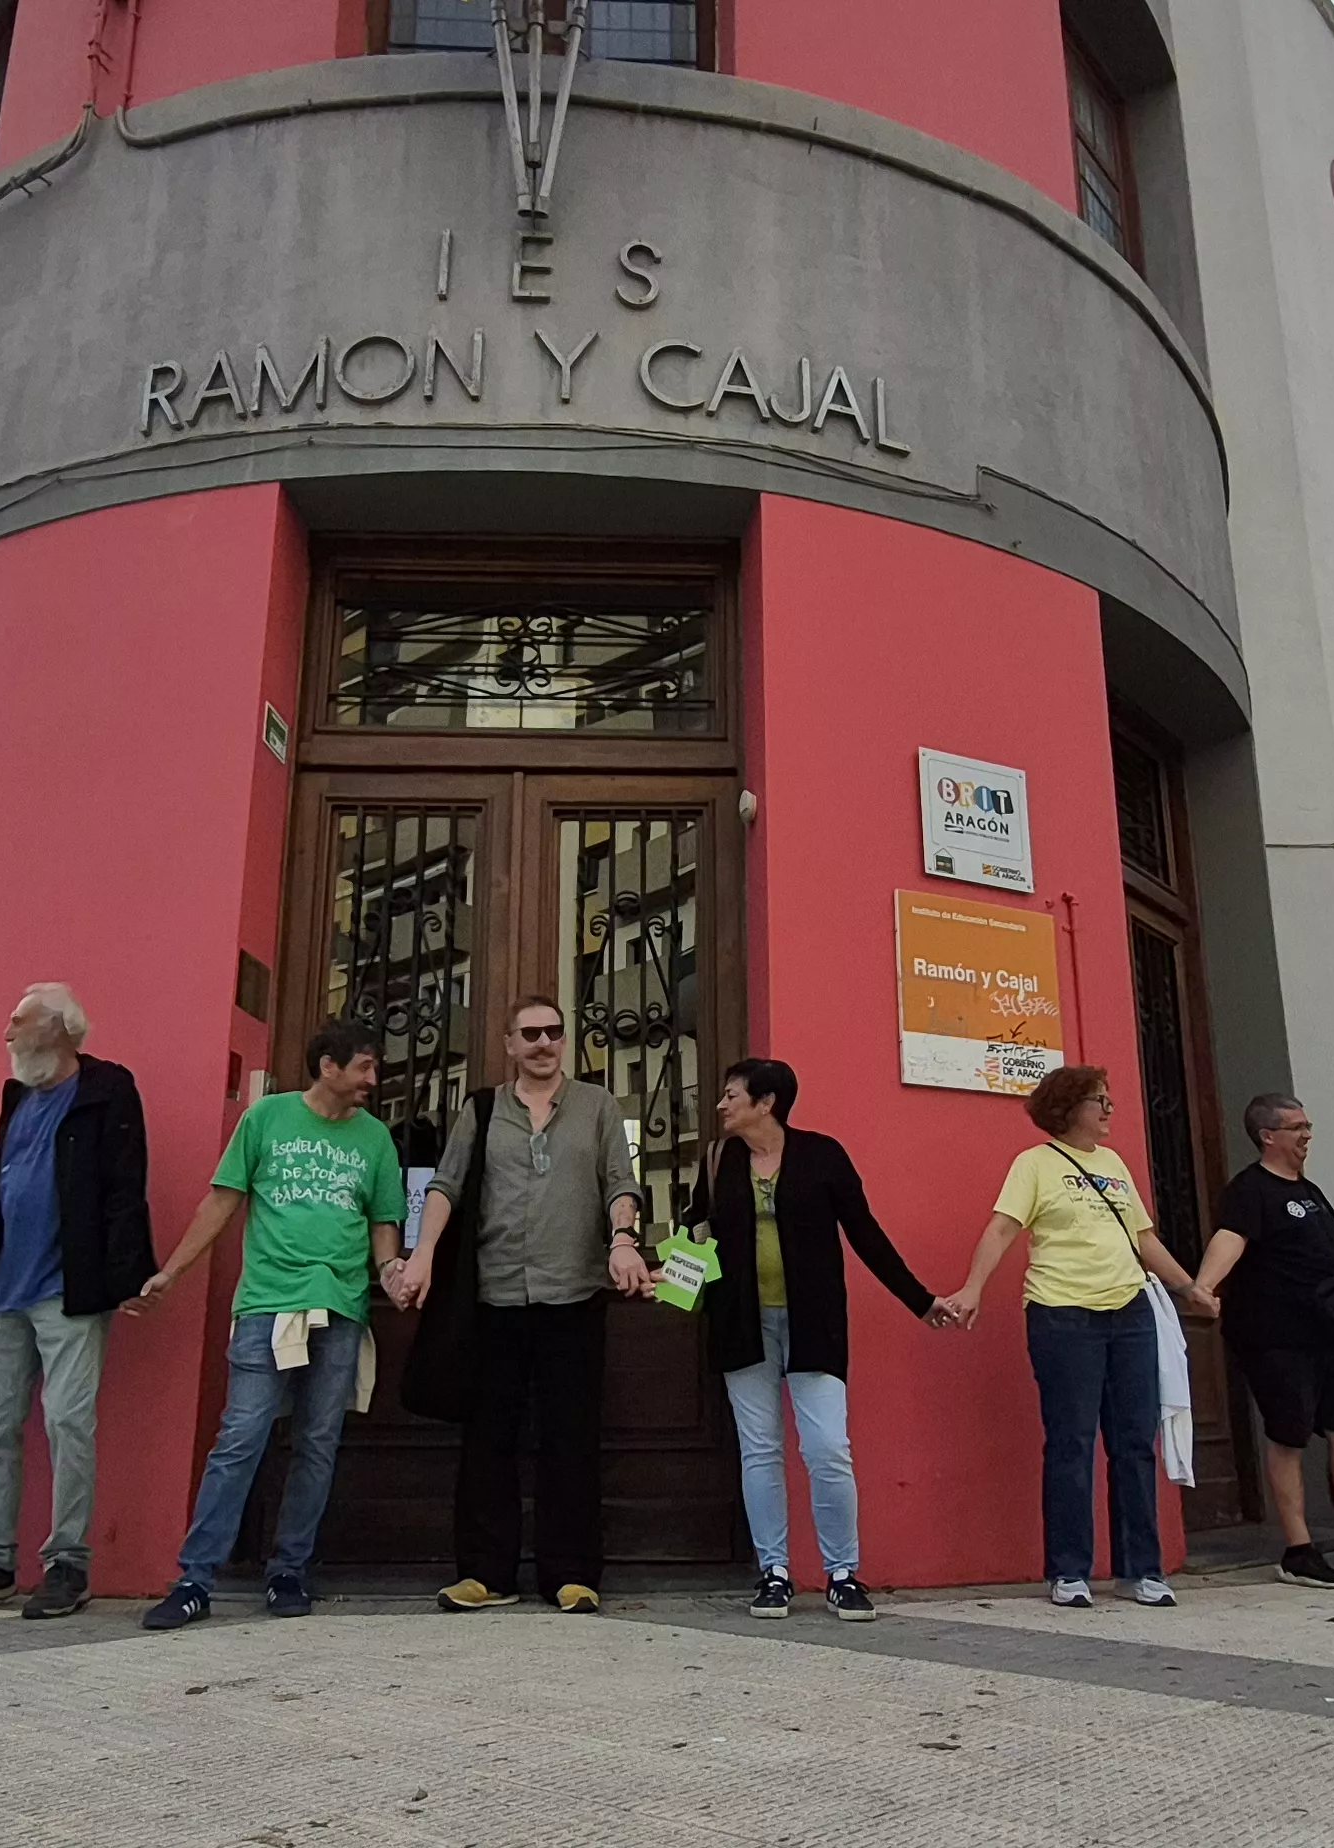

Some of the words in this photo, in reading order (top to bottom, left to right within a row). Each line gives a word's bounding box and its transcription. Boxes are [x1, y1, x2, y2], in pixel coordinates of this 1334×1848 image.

[140, 326, 486, 436] RAMON
[533, 328, 601, 403] Y
[638, 338, 913, 457] CAJAL
[939, 777, 1011, 815] BRIT
[944, 811, 1009, 835] ARAGÓN
[913, 957, 976, 983] Ramón
[981, 971, 991, 989] y
[996, 970, 1038, 996] Cajal
[1002, 1056, 1045, 1070] GOBIERNO
[1003, 1066, 1014, 1076] DE
[272, 1139, 322, 1156] ESCUELA
[327, 1144, 366, 1172] PÚBLICA
[283, 1167, 302, 1180] DE
[309, 1166, 356, 1188] TODOS
[274, 1186, 313, 1206] PARA
[314, 1188, 358, 1210] TODOS
